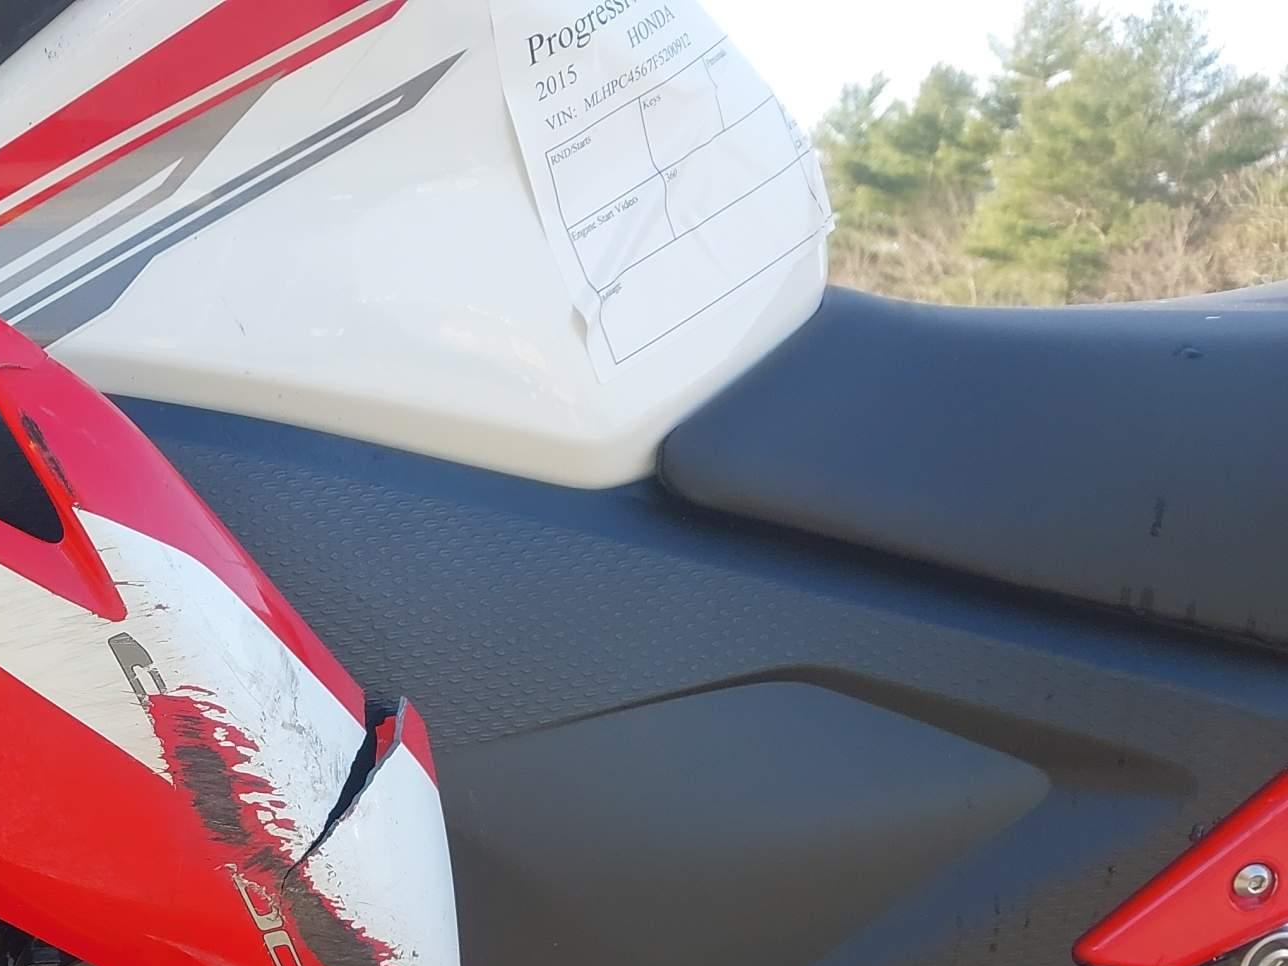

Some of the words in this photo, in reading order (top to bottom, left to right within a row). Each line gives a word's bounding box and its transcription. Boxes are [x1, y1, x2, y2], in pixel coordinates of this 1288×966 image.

[535, 64, 579, 102] 2015
[626, 5, 676, 48] HONDA
[544, 106, 578, 130] VIN:
